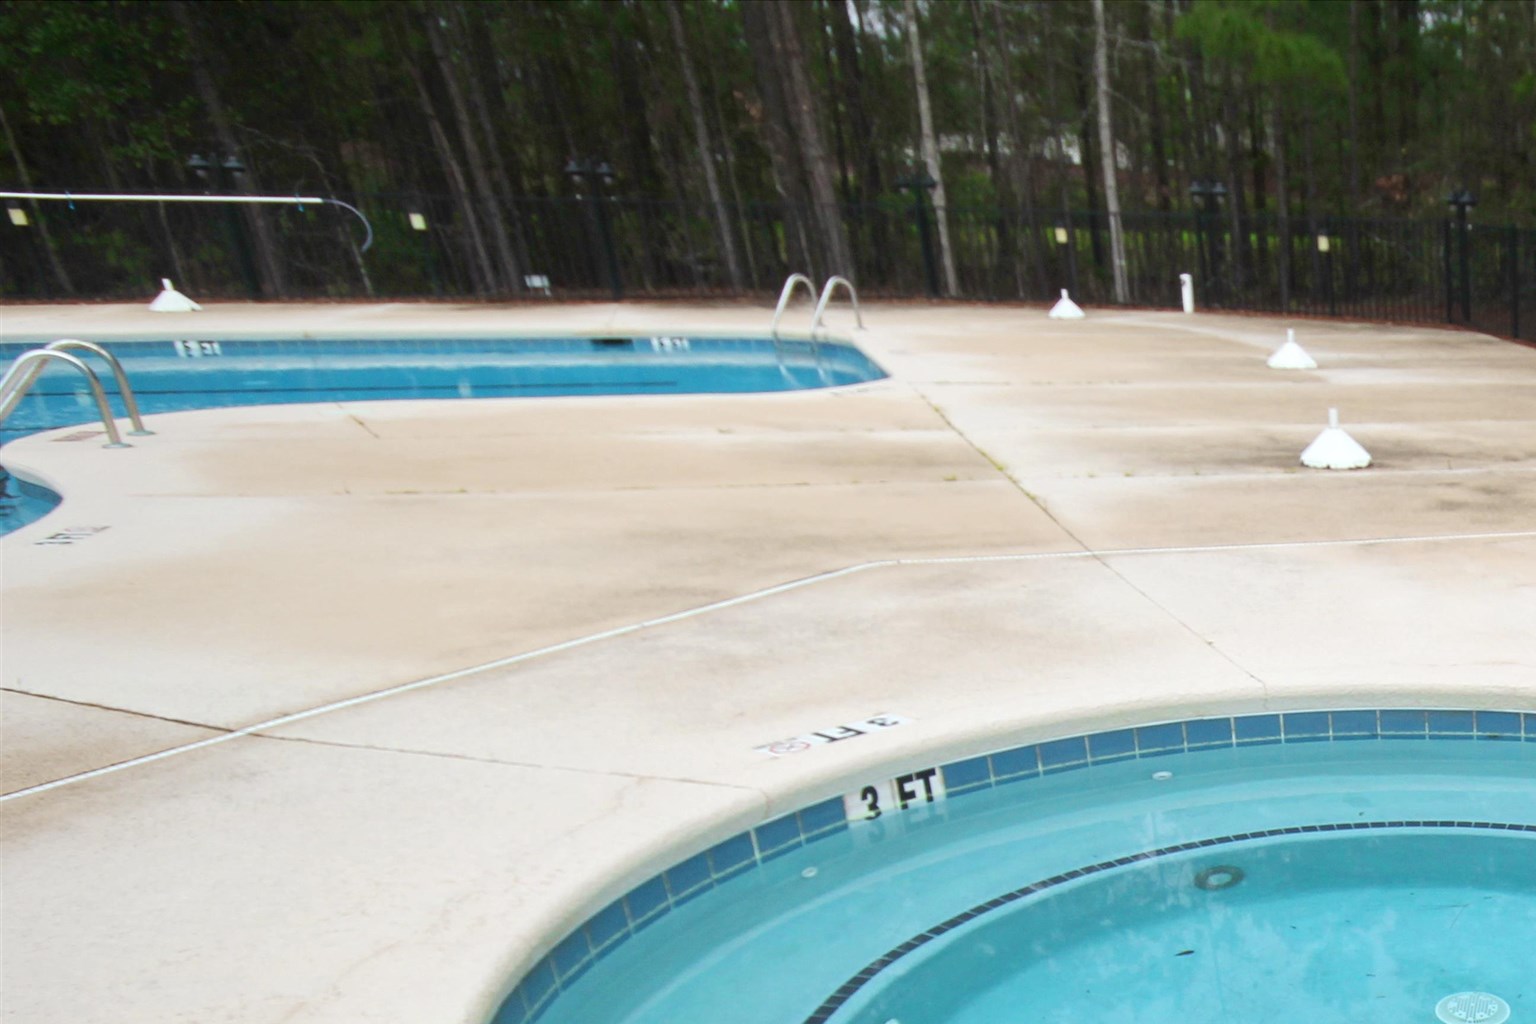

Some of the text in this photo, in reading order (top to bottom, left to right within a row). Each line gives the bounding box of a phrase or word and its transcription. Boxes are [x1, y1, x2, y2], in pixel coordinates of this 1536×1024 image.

[812, 725, 867, 744] FT
[861, 767, 936, 821] 3 FT
